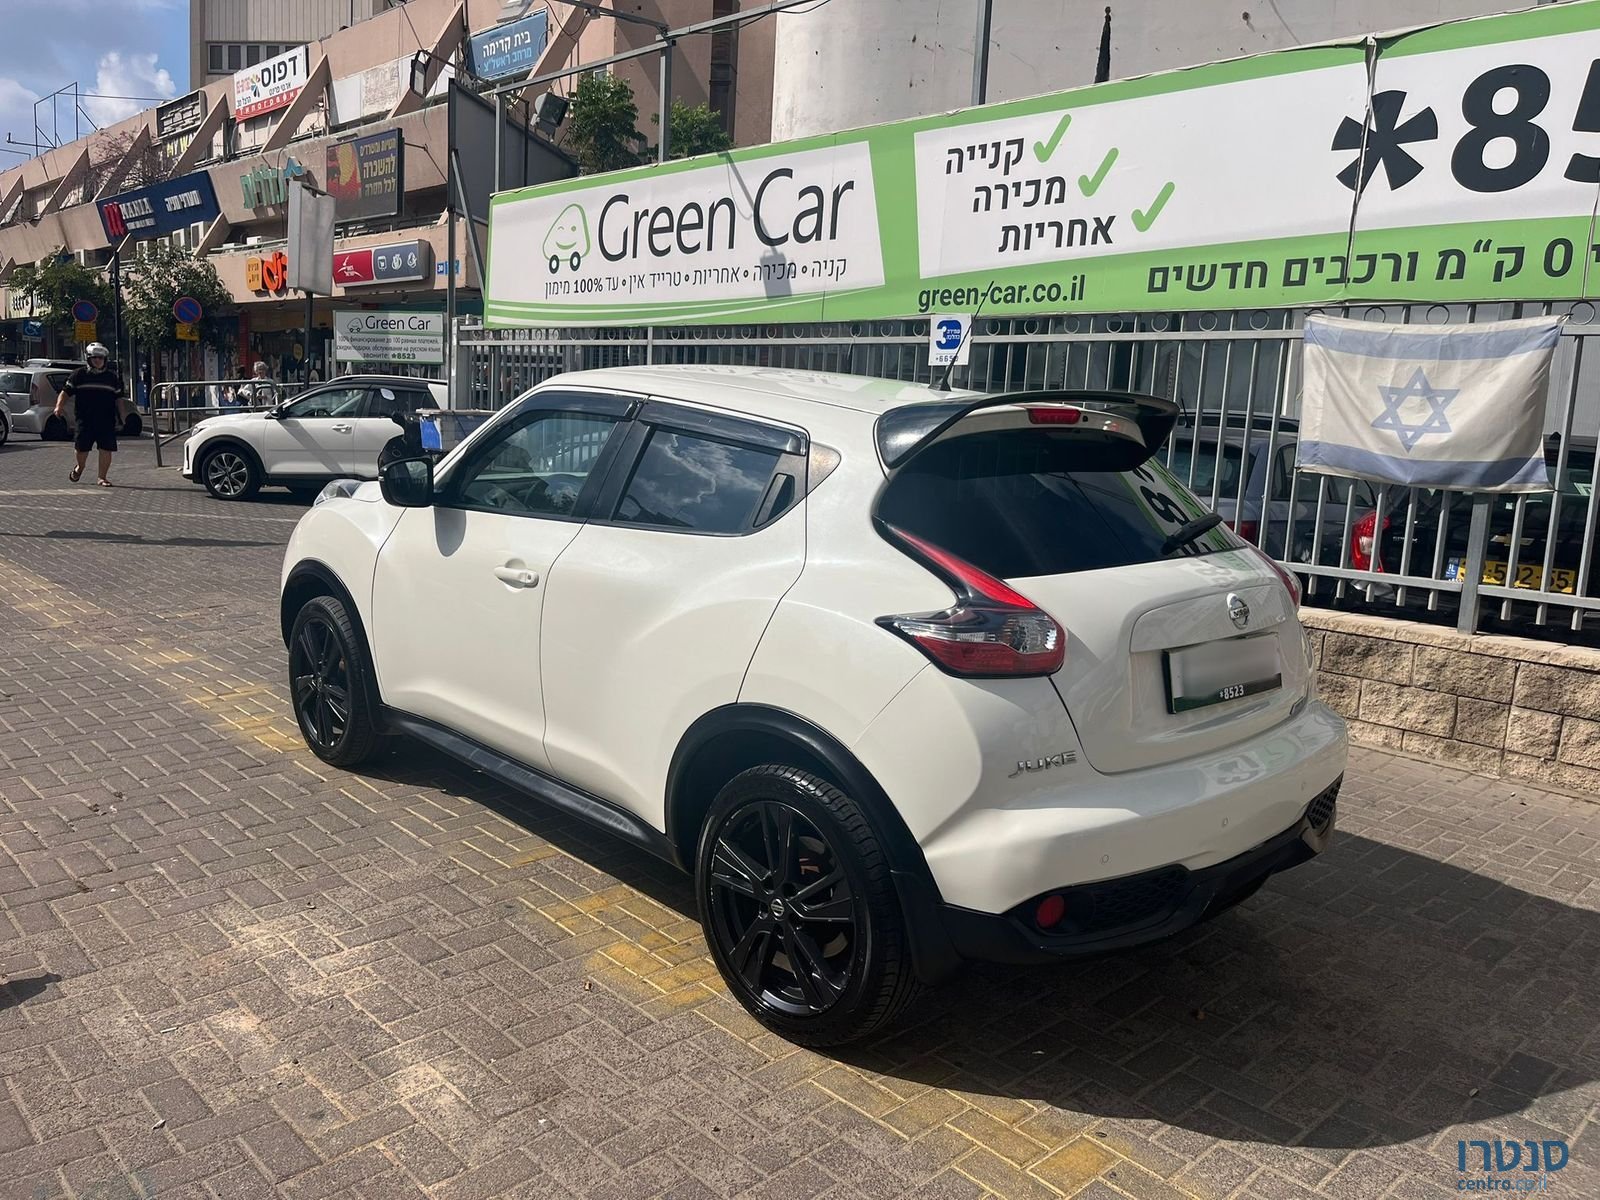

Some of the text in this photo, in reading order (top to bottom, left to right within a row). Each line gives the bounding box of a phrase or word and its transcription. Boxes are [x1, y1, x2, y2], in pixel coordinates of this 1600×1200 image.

[512, 47, 532, 62] מרחב
[514, 31, 531, 47] בית
[261, 56, 298, 88] דפוס
[363, 153, 396, 179] להשכרה
[946, 137, 1025, 176] קנייה
[972, 175, 1066, 213] מכירה
[598, 167, 854, 262] Green Car
[998, 215, 1116, 253] אחריות
[544, 257, 847, 300] קניה מכירה אחריות טרייד אין עד 100% מימון
[1147, 260, 1268, 293] חדשים
[1282, 250, 1419, 288] ורכבים
[918, 274, 1086, 313] green-car.co.il
[365, 316, 431, 330] Green Car
[1008, 750, 1078, 778] JUKE
